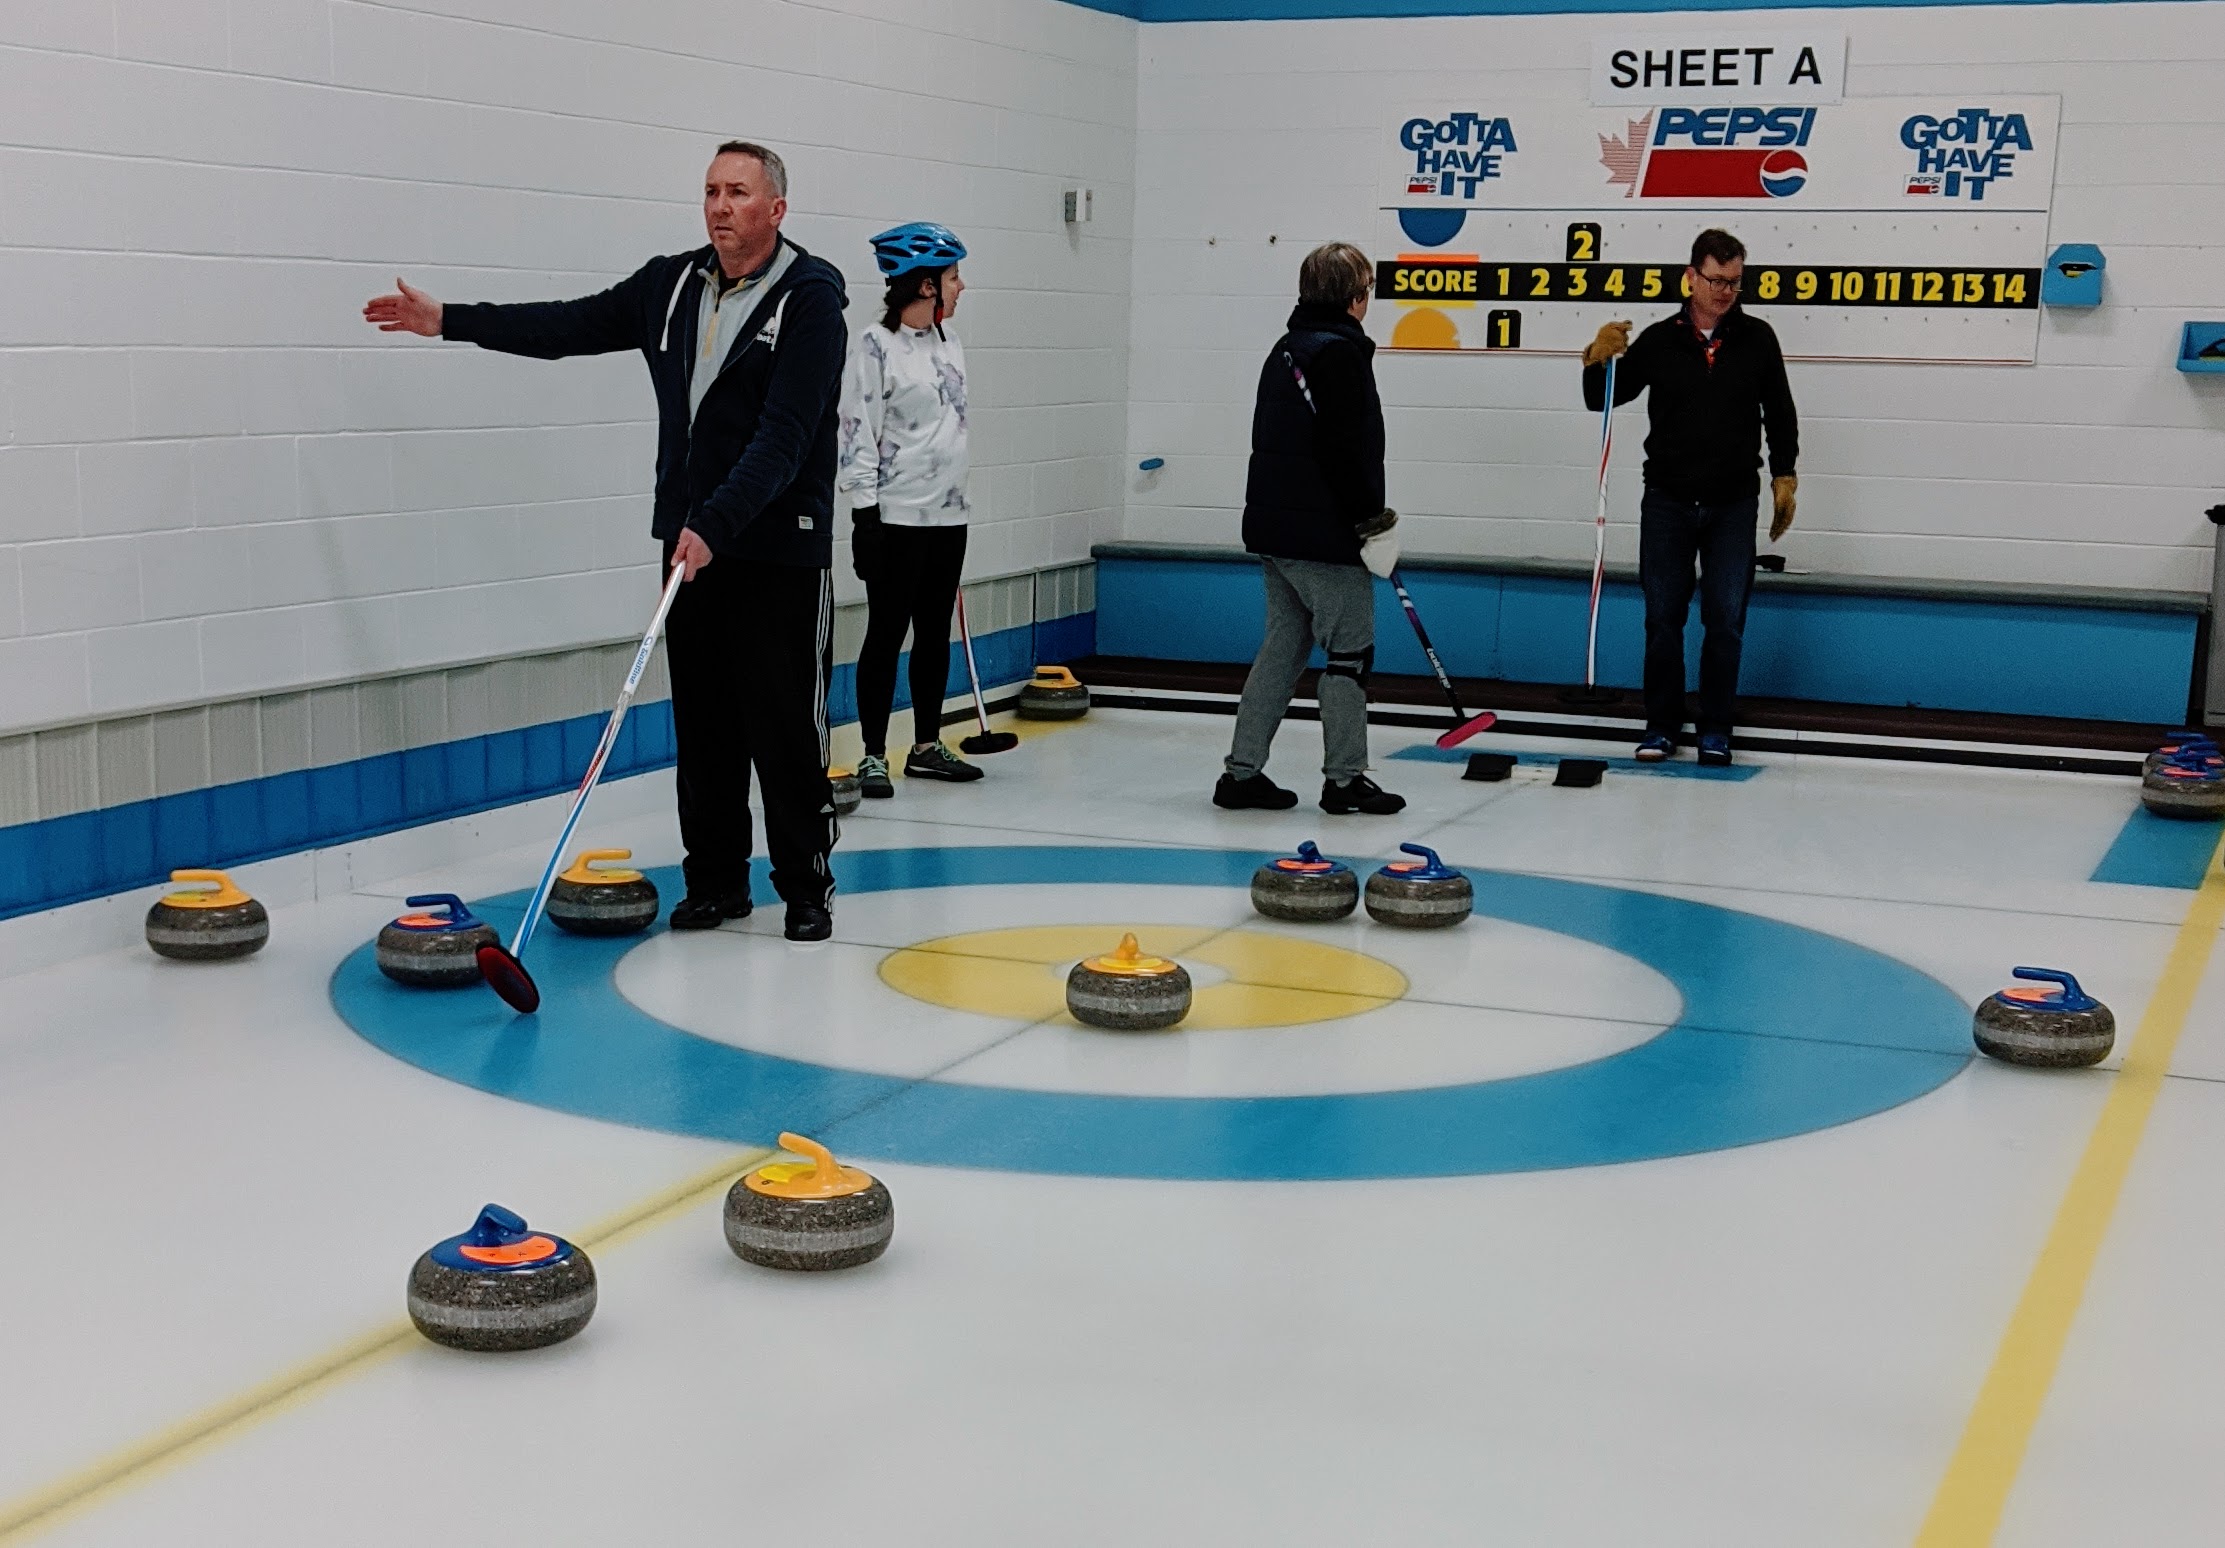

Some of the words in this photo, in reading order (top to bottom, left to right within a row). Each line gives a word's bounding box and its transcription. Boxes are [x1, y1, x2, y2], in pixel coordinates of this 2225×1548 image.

[1610, 48, 1774, 88] SHEET
[1788, 46, 1822, 85] A
[1400, 112, 1517, 152] GOTTA
[1653, 107, 1818, 146] PEPSI
[1900, 108, 2033, 150] GOTTA
[1417, 149, 1502, 177] HAVE
[1918, 147, 2015, 177] HAVE
[1409, 176, 1438, 184] PEPSI
[1440, 171, 1485, 199] IT
[1909, 176, 1941, 184] PEPSI
[1944, 171, 1995, 200] IT
[1572, 230, 1594, 260] 2
[1394, 269, 1478, 293] SCORE
[1497, 267, 1510, 296] 1
[1529, 268, 1550, 296] 2
[1567, 268, 1588, 296] 3
[1604, 268, 1626, 297] 4
[1641, 268, 1663, 298] 5
[1758, 270, 1781, 300] 8
[1796, 270, 1818, 300] 9
[1830, 271, 1864, 301] 10
[1874, 271, 1901, 301] 11
[1911, 271, 1944, 301] 12
[1951, 272, 1985, 303] 13
[1993, 273, 2027, 303] 14
[1497, 318, 1511, 347] 1
